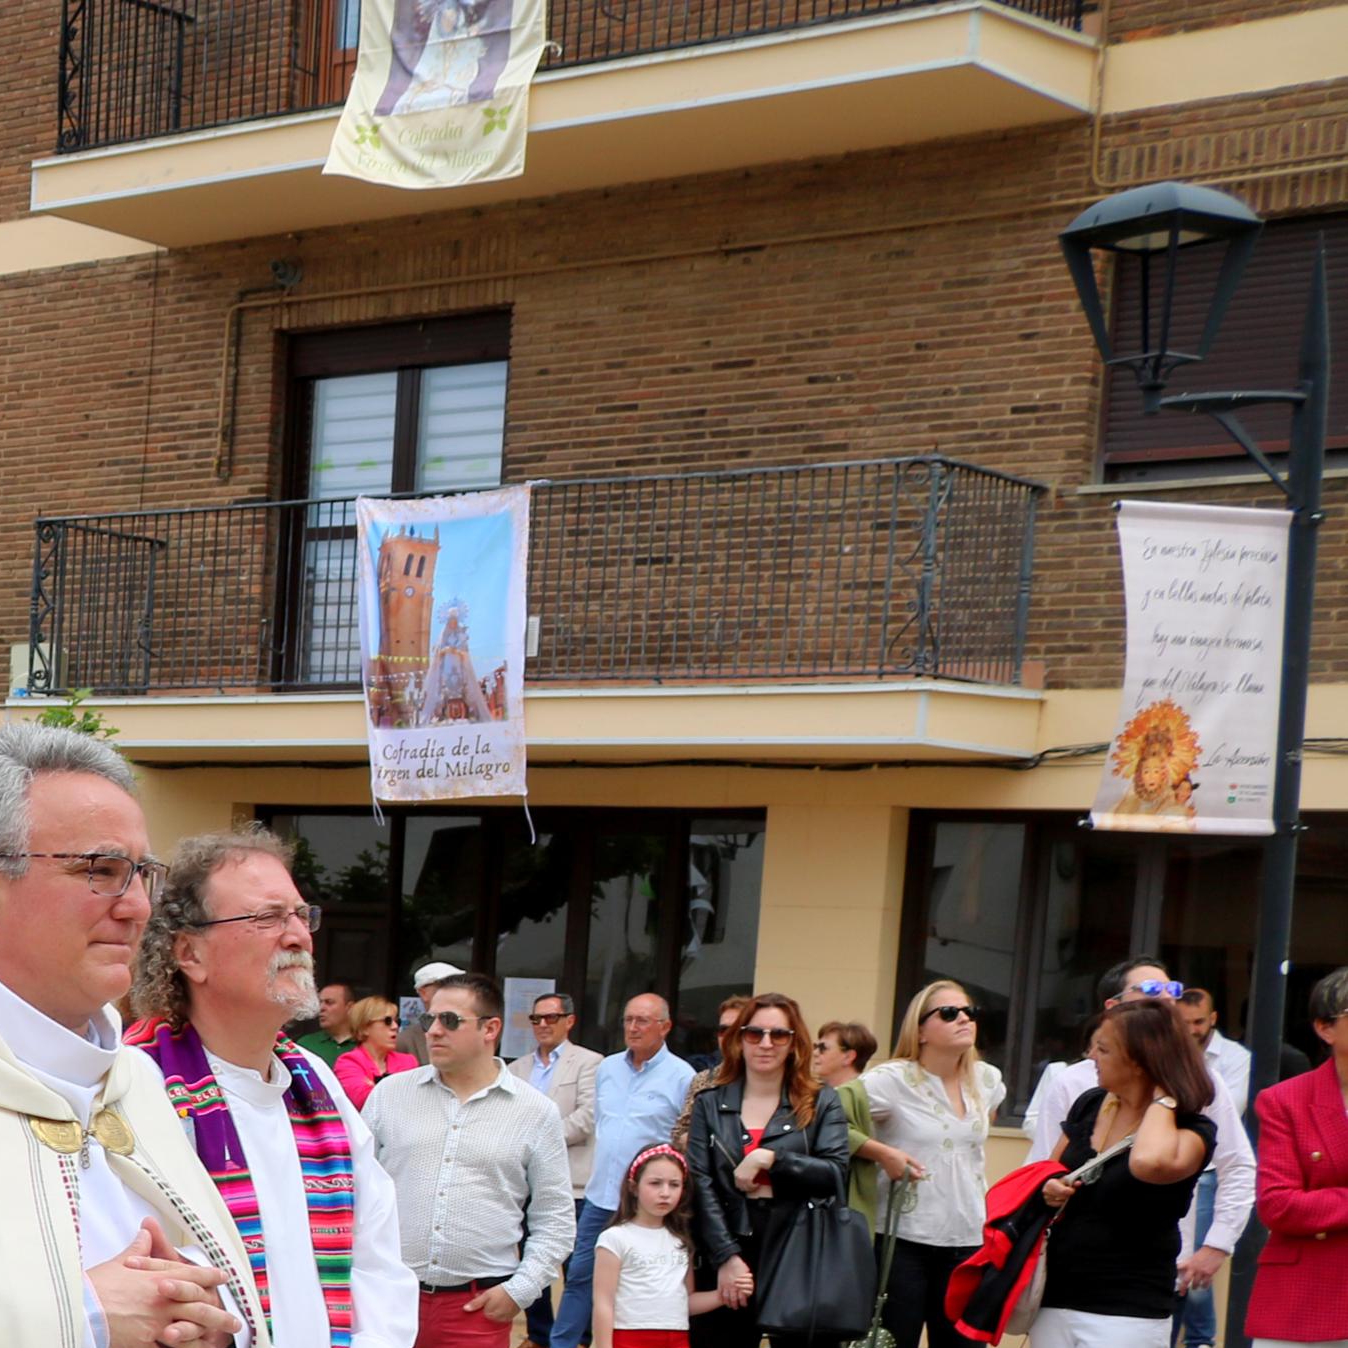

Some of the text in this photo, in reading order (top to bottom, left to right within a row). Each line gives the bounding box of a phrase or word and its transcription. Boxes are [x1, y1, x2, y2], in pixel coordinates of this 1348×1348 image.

[1143, 537, 1278, 572] En nuestra Iglesia preciosa
[1141, 590, 1151, 611] y
[1154, 590, 1165, 600] en
[1168, 578, 1197, 603] bellas
[1231, 582, 1243, 602] de
[1153, 622, 1168, 657] hay
[1171, 636, 1186, 645] una
[1190, 631, 1221, 661] imagen
[1135, 678, 1157, 708] que
[1160, 667, 1182, 688] del
[1180, 671, 1218, 706] Milagro
[382, 734, 491, 765] Cofradía de la
[1202, 742, 1226, 767] La
[374, 756, 510, 787] irgen del Milagro
